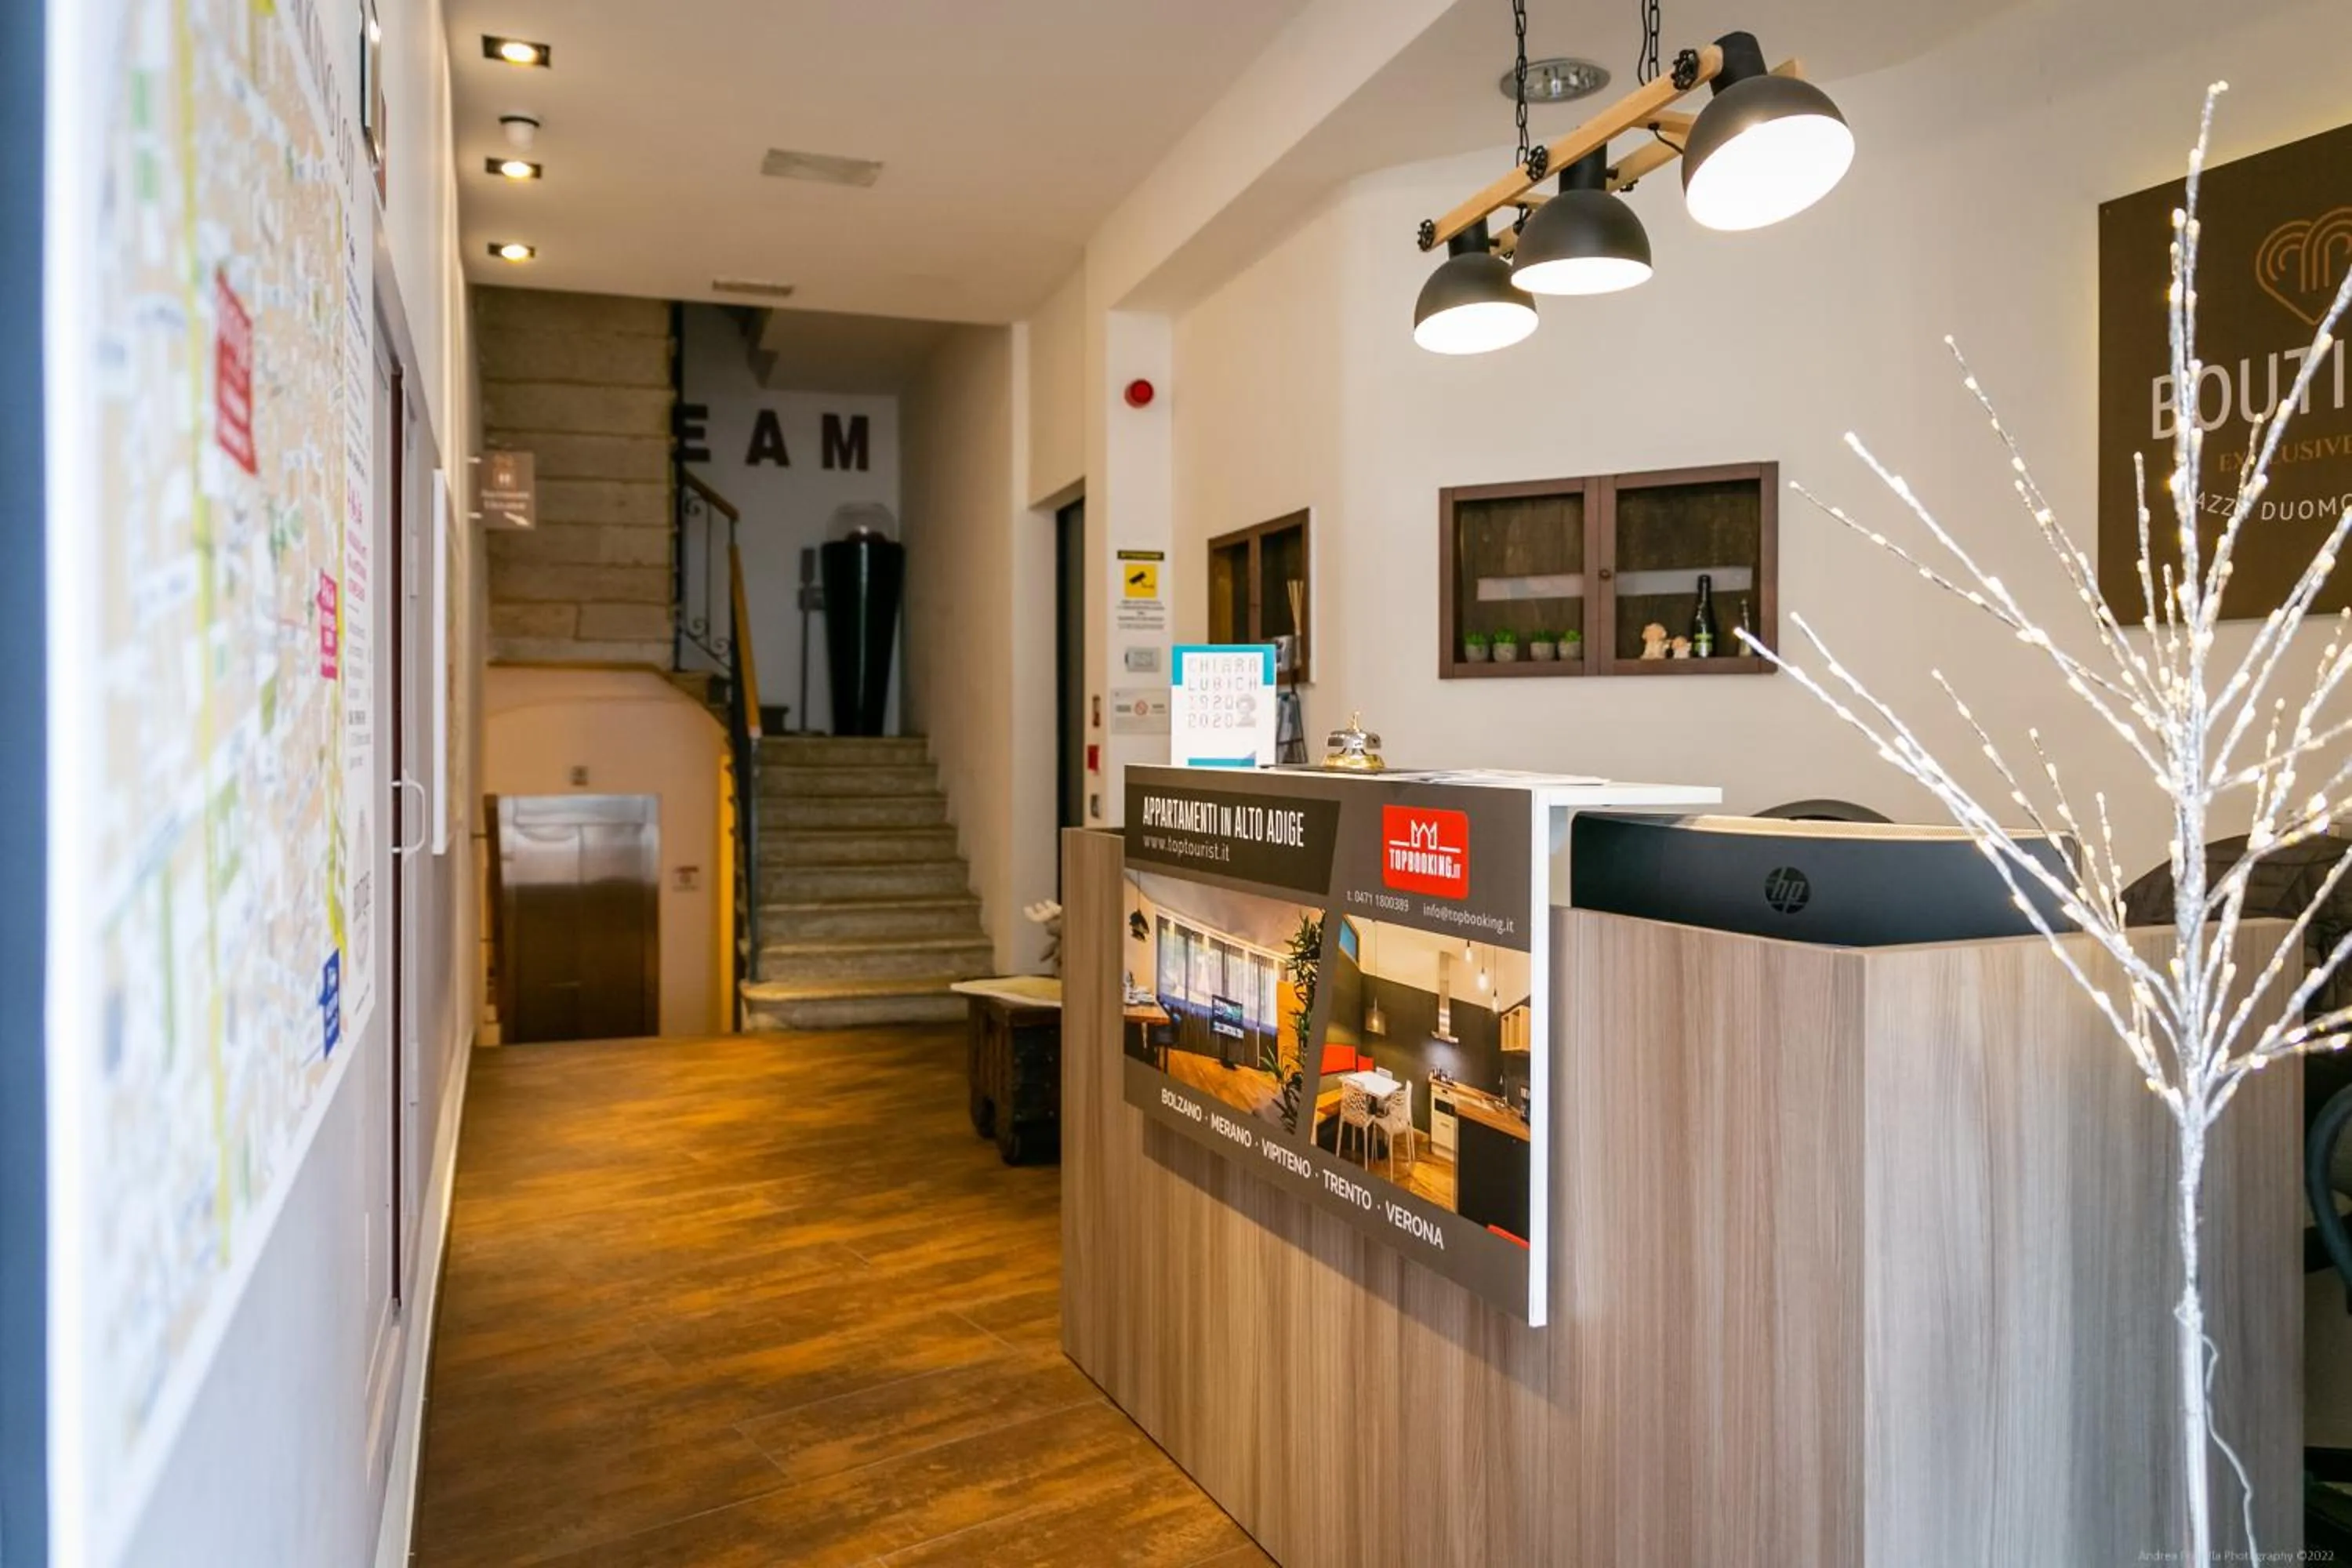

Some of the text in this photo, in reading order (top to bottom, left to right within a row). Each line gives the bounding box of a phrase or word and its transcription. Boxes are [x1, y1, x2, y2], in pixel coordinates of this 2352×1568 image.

[1188, 677, 1258, 691] LUBICH
[1142, 796, 1218, 835] APPARTAMENTI
[1234, 805, 1263, 841] ALTO
[1266, 808, 1305, 848] ADIGE
[1142, 834, 1230, 862] www.toptourist.it
[1354, 890, 1372, 903] 0471
[1375, 894, 1409, 912] 1800389
[1423, 902, 1515, 934] info@topbooking.it
[1769, 866, 1806, 915] hp
[1161, 1087, 1444, 1250] BOLZANO MERANO VIPITENO TRENTO VERONA
